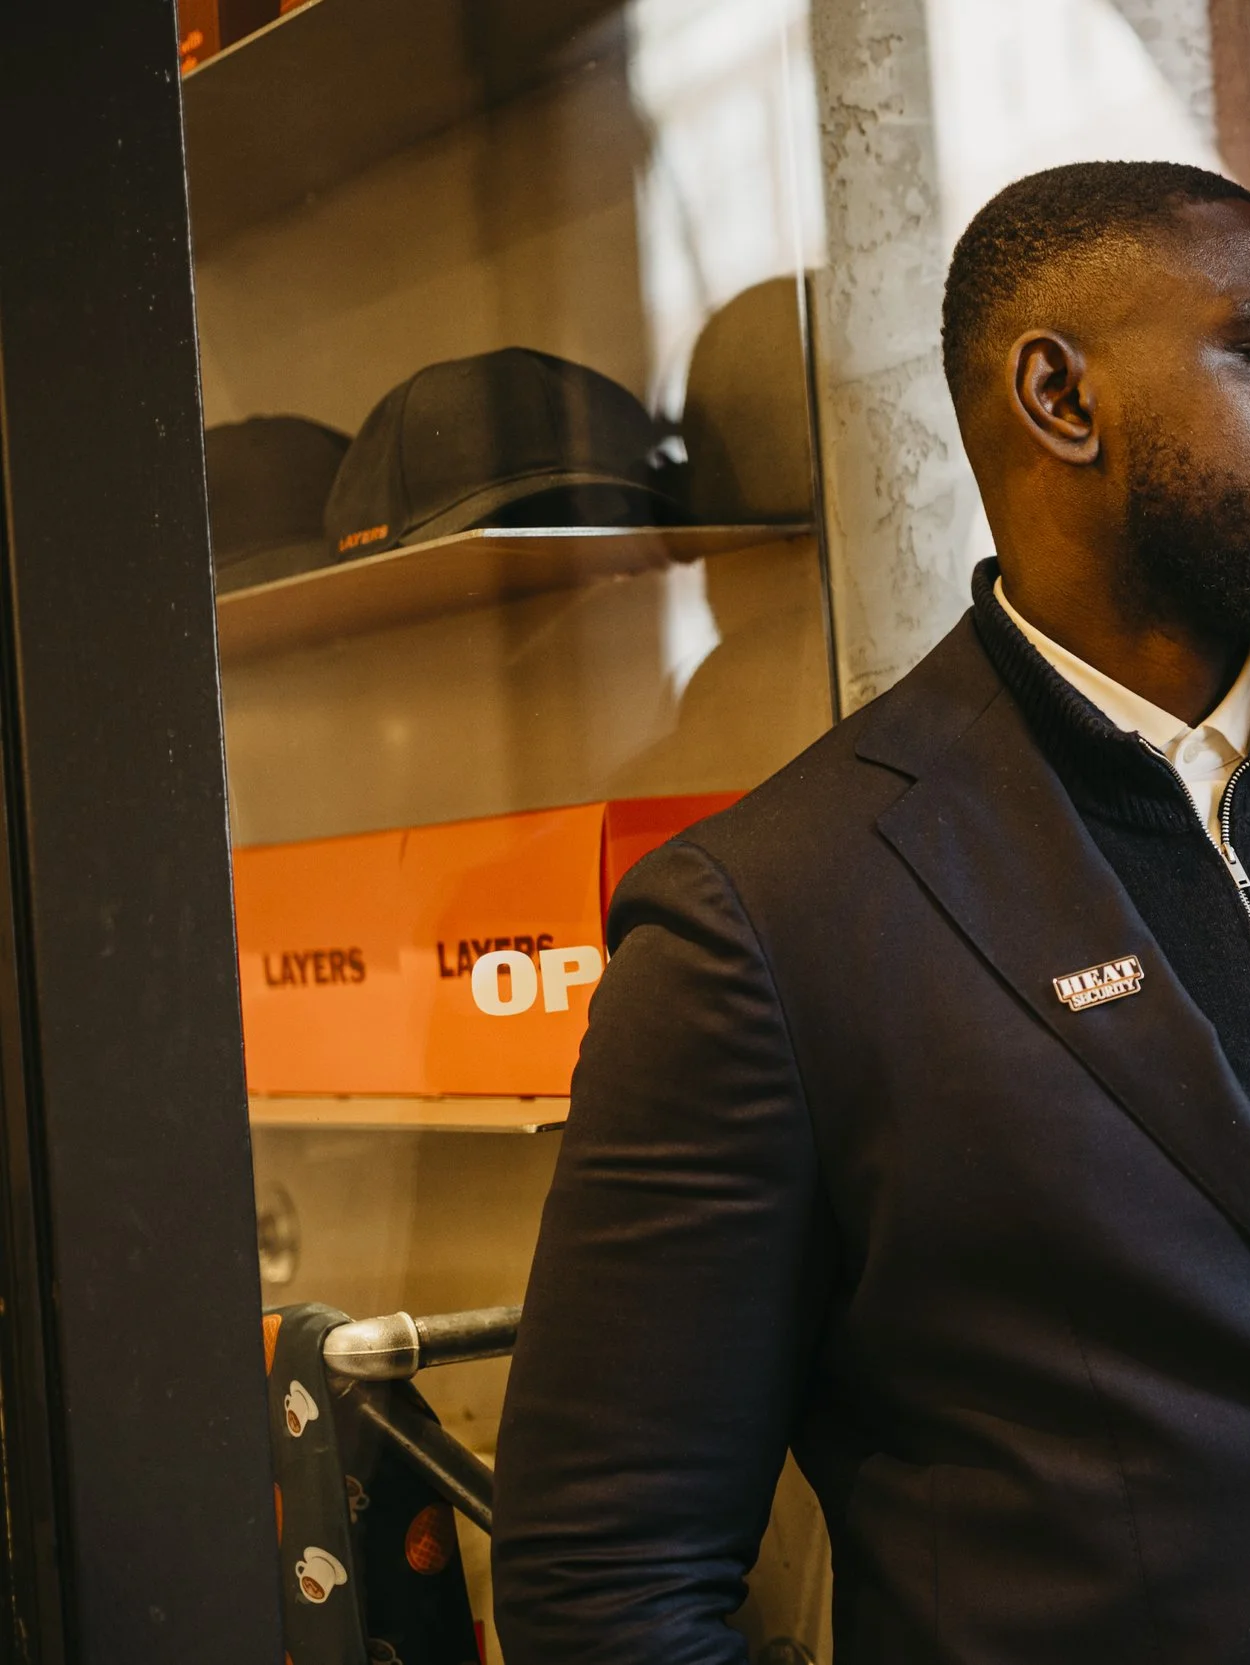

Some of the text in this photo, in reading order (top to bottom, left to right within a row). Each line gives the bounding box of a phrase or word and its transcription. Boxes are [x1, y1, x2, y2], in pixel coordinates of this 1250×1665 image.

[263, 947, 366, 987] LAYERS
[471, 944, 612, 1016] OP
[1058, 958, 1137, 998] HEAT
[1071, 977, 1136, 1008] SECURITY
